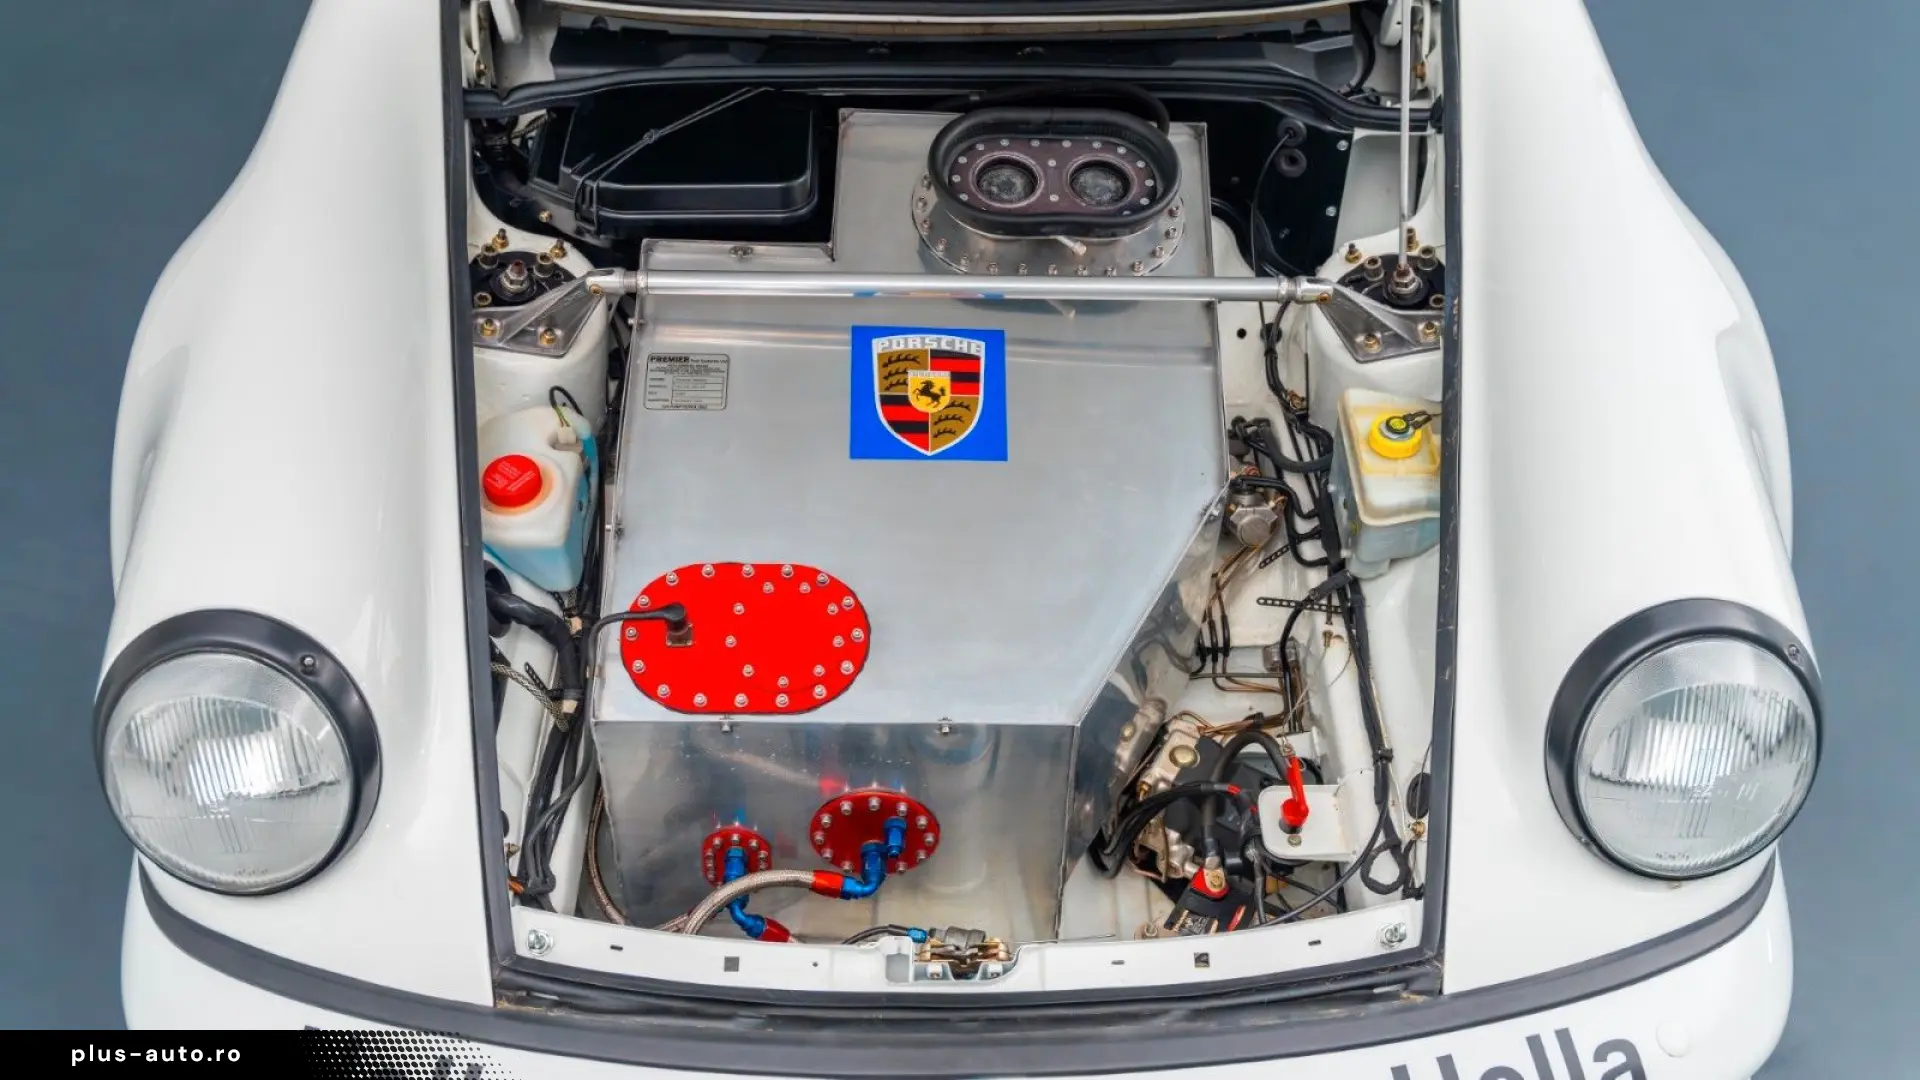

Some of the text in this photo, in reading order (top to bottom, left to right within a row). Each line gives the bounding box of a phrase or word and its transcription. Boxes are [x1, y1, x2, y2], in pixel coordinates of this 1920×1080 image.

[878, 336, 982, 355] PORSCHE
[649, 355, 690, 363] PREMIER
[1391, 1027, 1649, 1080] lla
